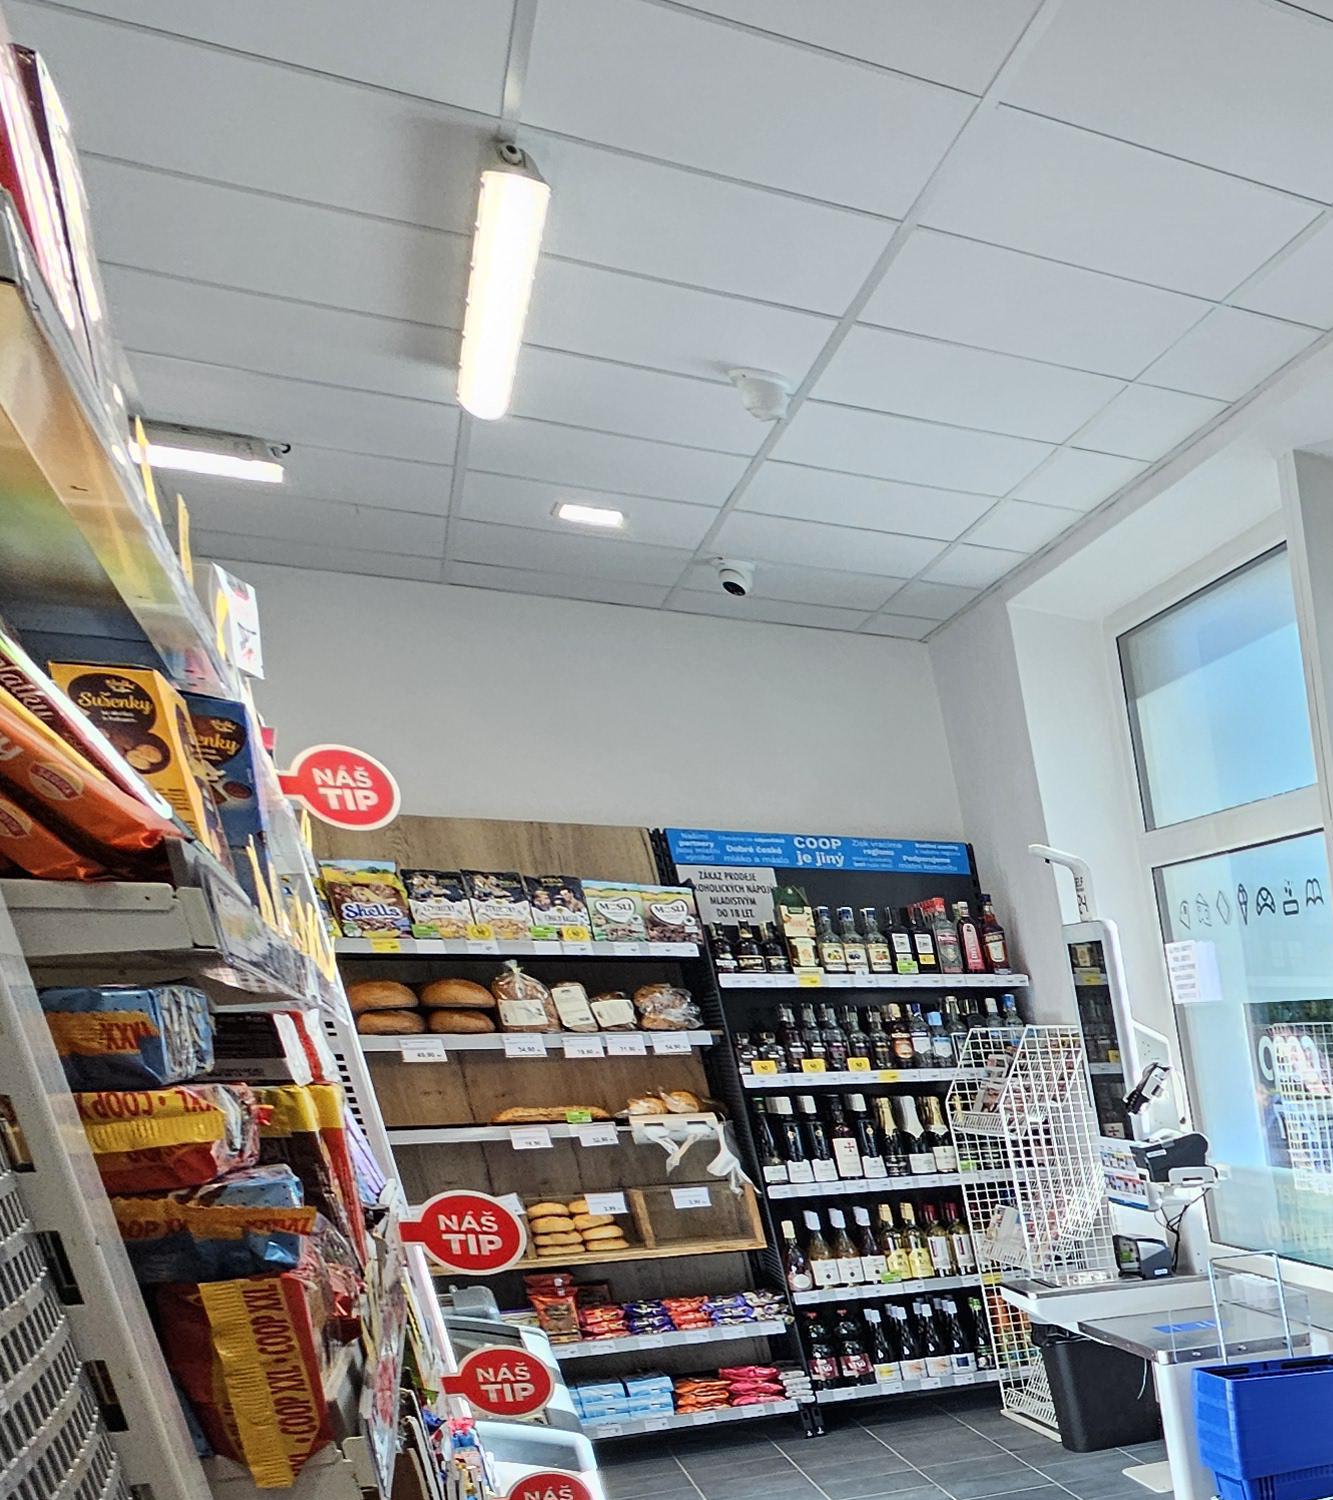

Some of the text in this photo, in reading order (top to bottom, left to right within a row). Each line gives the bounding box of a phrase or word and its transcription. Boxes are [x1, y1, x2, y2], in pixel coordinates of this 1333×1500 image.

[78, 692, 152, 714] Sušenky
[312, 765, 374, 788] NÁŠ
[318, 786, 379, 813] TIP
[794, 837, 841, 849] COOP
[796, 851, 844, 866] je jiný
[438, 1211, 498, 1233] NÁŠ
[442, 1233, 503, 1255] TIP
[479, 1383, 535, 1402] TIP
